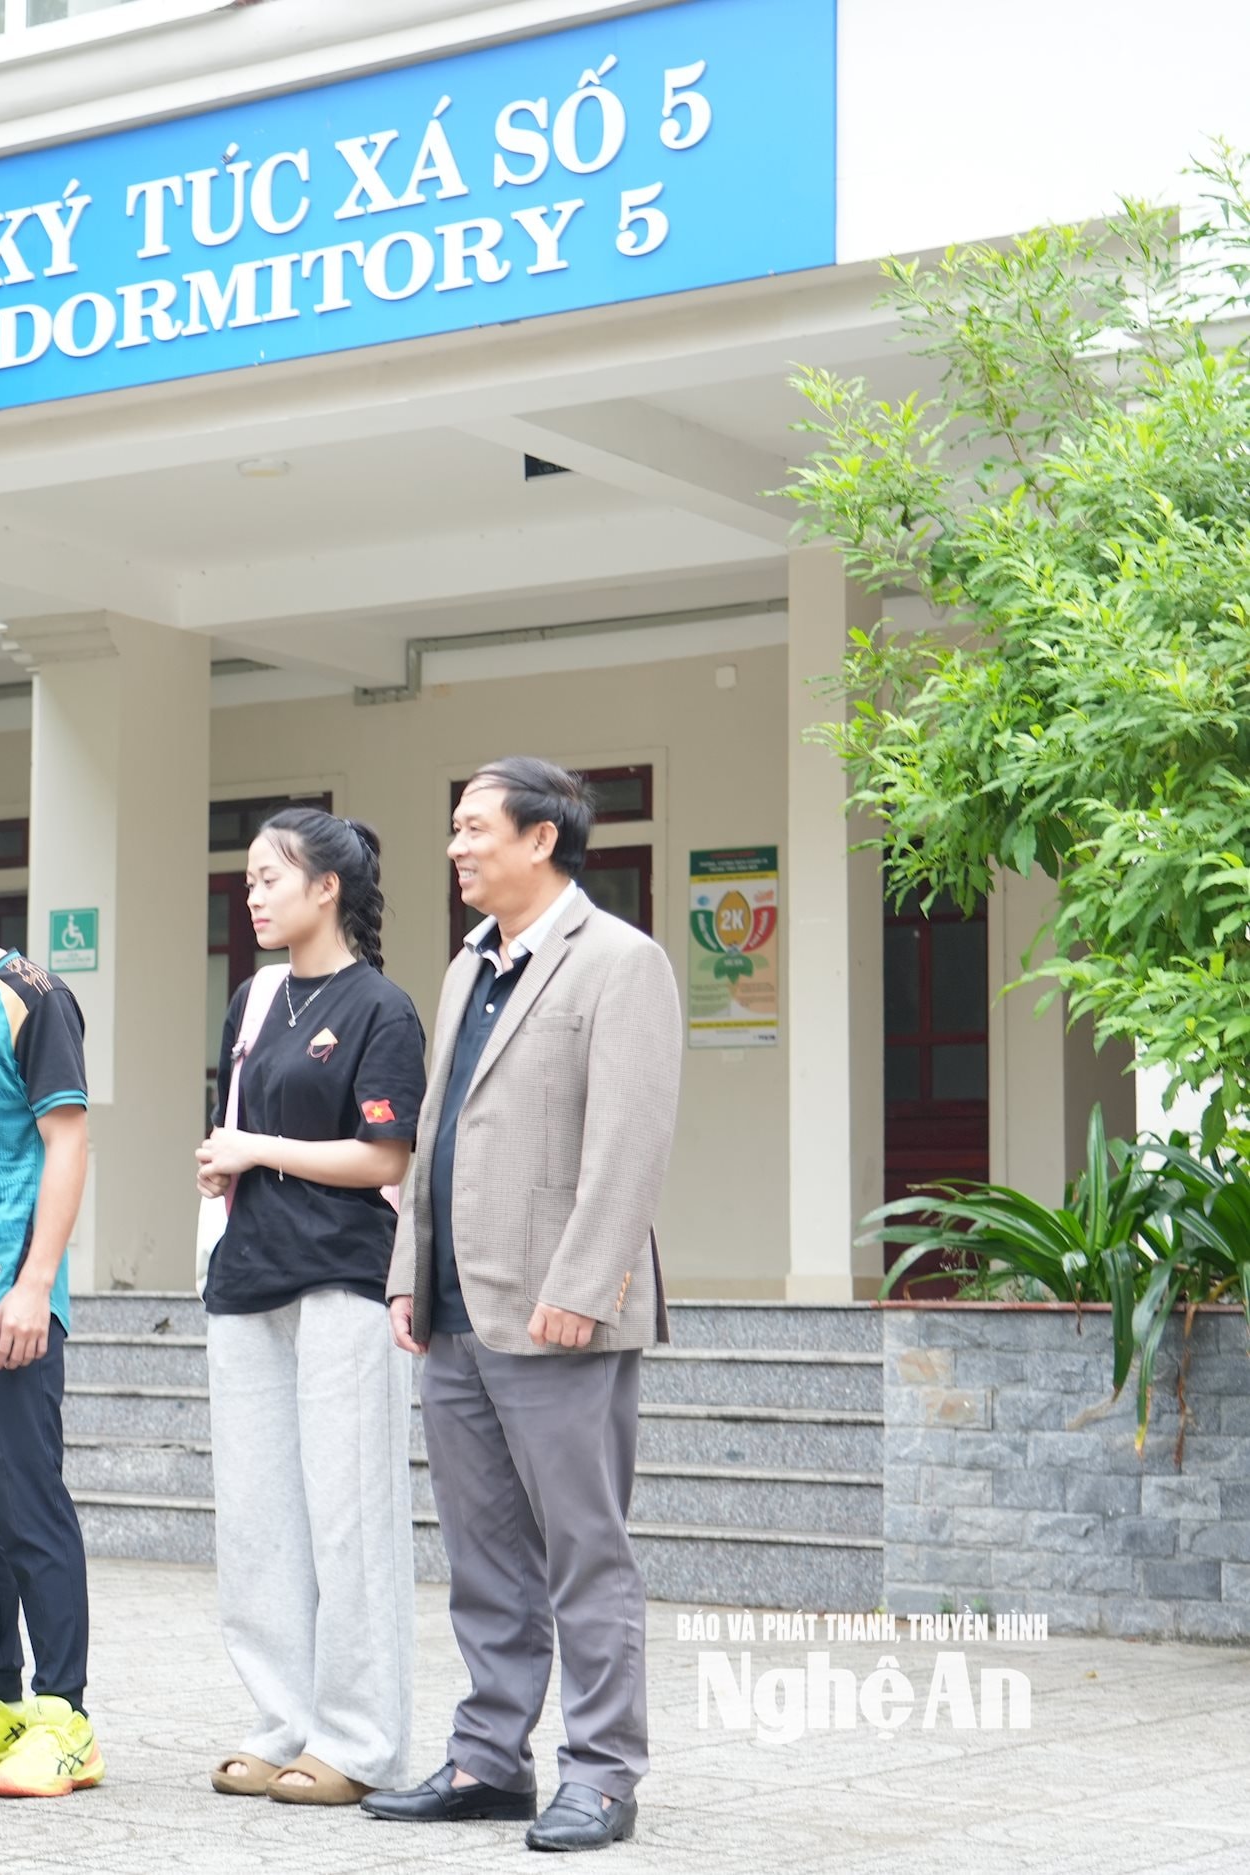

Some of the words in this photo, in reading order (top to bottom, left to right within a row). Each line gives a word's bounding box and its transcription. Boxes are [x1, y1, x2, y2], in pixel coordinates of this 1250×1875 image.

[126, 142, 310, 259] TÚC
[333, 95, 469, 220] XÁ
[493, 54, 626, 188] SỐ
[658, 60, 711, 150] 5
[615, 181, 669, 257] 5
[720, 909, 745, 930] 2K
